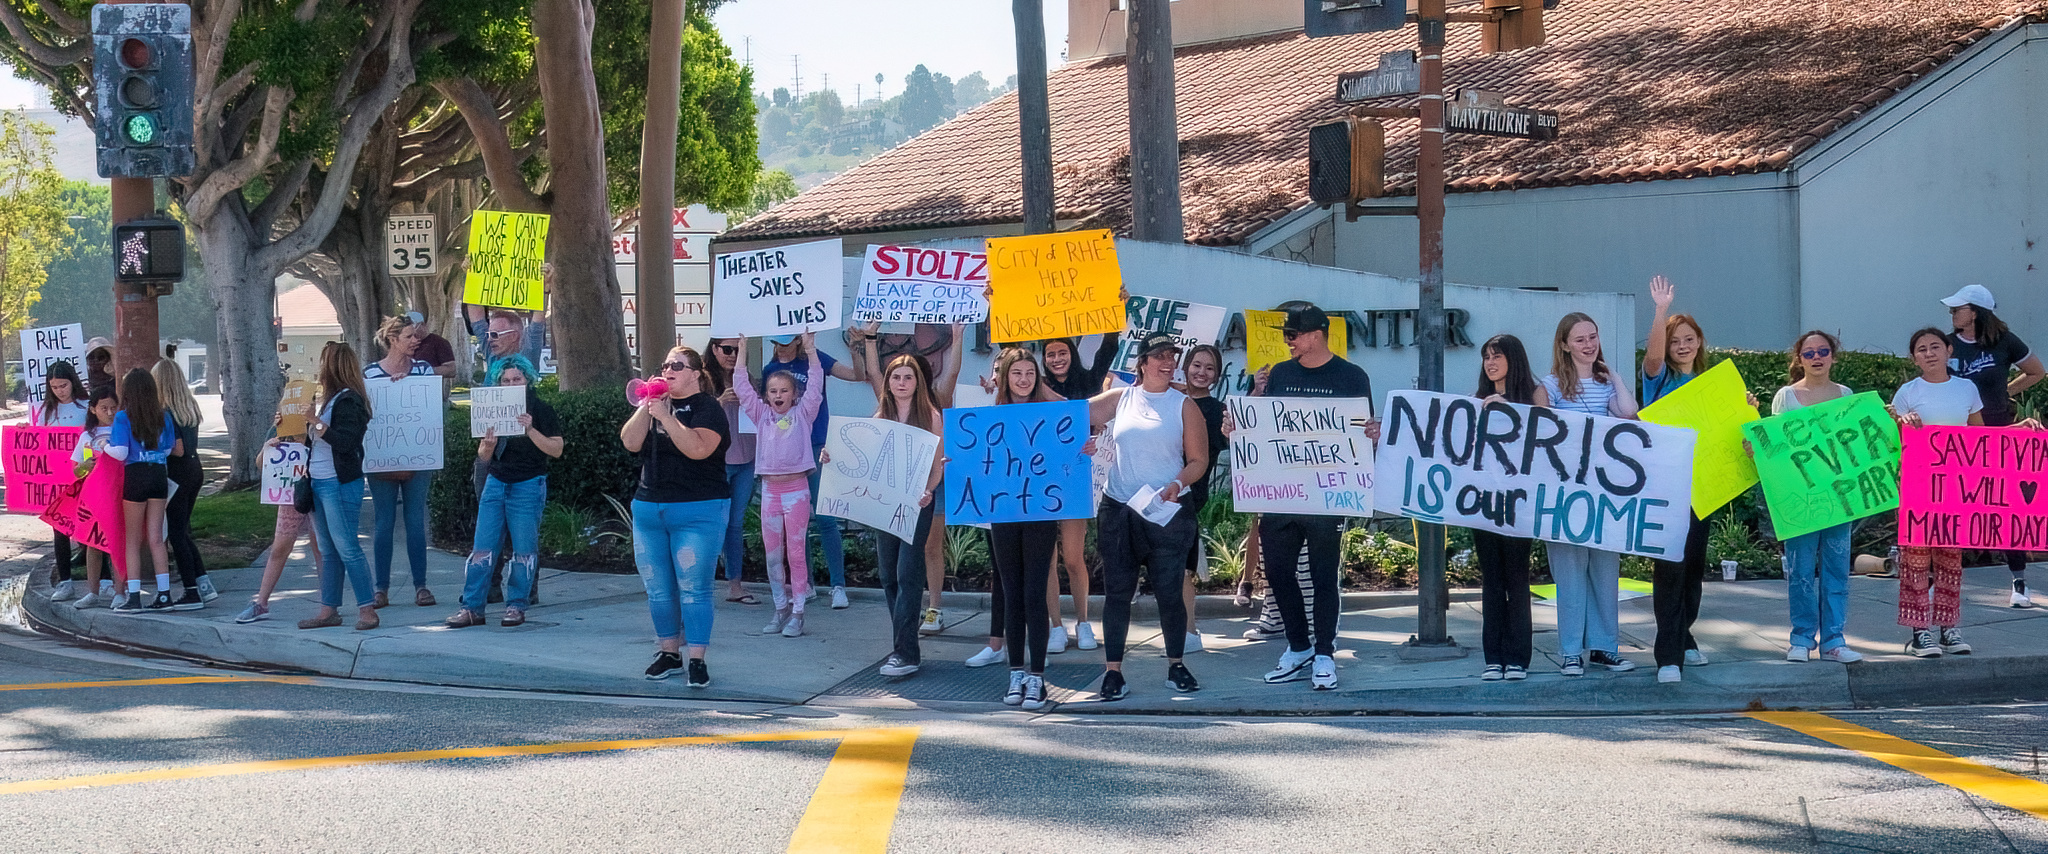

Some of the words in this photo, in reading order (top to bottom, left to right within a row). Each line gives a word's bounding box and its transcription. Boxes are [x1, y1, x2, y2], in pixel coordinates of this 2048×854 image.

[1340, 75, 1374, 100] SILVER
[1375, 72, 1403, 95] SPUR
[1450, 106, 1530, 134] HAWTHORNE
[1537, 113, 1557, 129] BLVD
[389, 220, 433, 230] SPEED
[486, 212, 510, 239] WE
[393, 234, 429, 244] LIMIT
[479, 235, 507, 257] LOSE
[511, 237, 537, 260] OUR
[392, 248, 432, 270] 35
[718, 251, 788, 279] THEATER
[872, 246, 988, 281] STOLTZ
[997, 247, 1038, 269] CITY
[480, 275, 510, 306] HELP
[511, 281, 530, 307] US!
[749, 272, 804, 299] SAVES
[866, 282, 922, 298] LEAVE
[932, 285, 975, 300] OUR
[1039, 268, 1078, 289] HELP
[856, 297, 886, 310] KIDS
[890, 299, 918, 311] OUT
[923, 300, 945, 313] OF
[1035, 293, 1055, 307] US
[1061, 286, 1096, 304] SAVE
[776, 301, 826, 327] LIVES
[856, 310, 882, 321] THIS
[890, 311, 902, 320] IS
[909, 312, 946, 323] THEIR
[996, 313, 1055, 339] NORRIS
[1053, 305, 1121, 335] THEATRE
[1126, 296, 1190, 335] RHE
[36, 328, 72, 350] RHE
[1255, 330, 1280, 343] OUR
[1256, 344, 1285, 357] ARTS
[400, 385, 429, 410] LET
[491, 389, 504, 403] THE
[472, 404, 524, 420] CONSERVATORY
[1230, 397, 1257, 430] NO
[1272, 400, 1346, 433] PARKING
[494, 421, 503, 433] OF
[954, 412, 1074, 450] Save
[14, 431, 39, 451] KIDS
[1234, 436, 1258, 470] NO
[1386, 395, 1652, 496] NORRIS
[1790, 415, 1899, 489] PVPA
[1930, 431, 1990, 467] SAVE
[13, 454, 53, 475] LOCAL
[981, 446, 1047, 477] the
[840, 485, 892, 505] the
[953, 477, 1063, 517] Arts
[1234, 475, 1309, 501] PROMENADE,
[1316, 471, 1347, 488] LET
[1356, 473, 1374, 489] US
[1932, 473, 1947, 503] IT
[1959, 474, 2010, 507] WILL
[821, 496, 850, 516] PVPA
[1324, 490, 1365, 512] PARK
[1403, 456, 1453, 514] IS
[1456, 484, 1528, 527] our
[1533, 483, 1670, 554] HOME
[1908, 510, 1961, 546] MAKE
[1970, 512, 2003, 547] OUR
